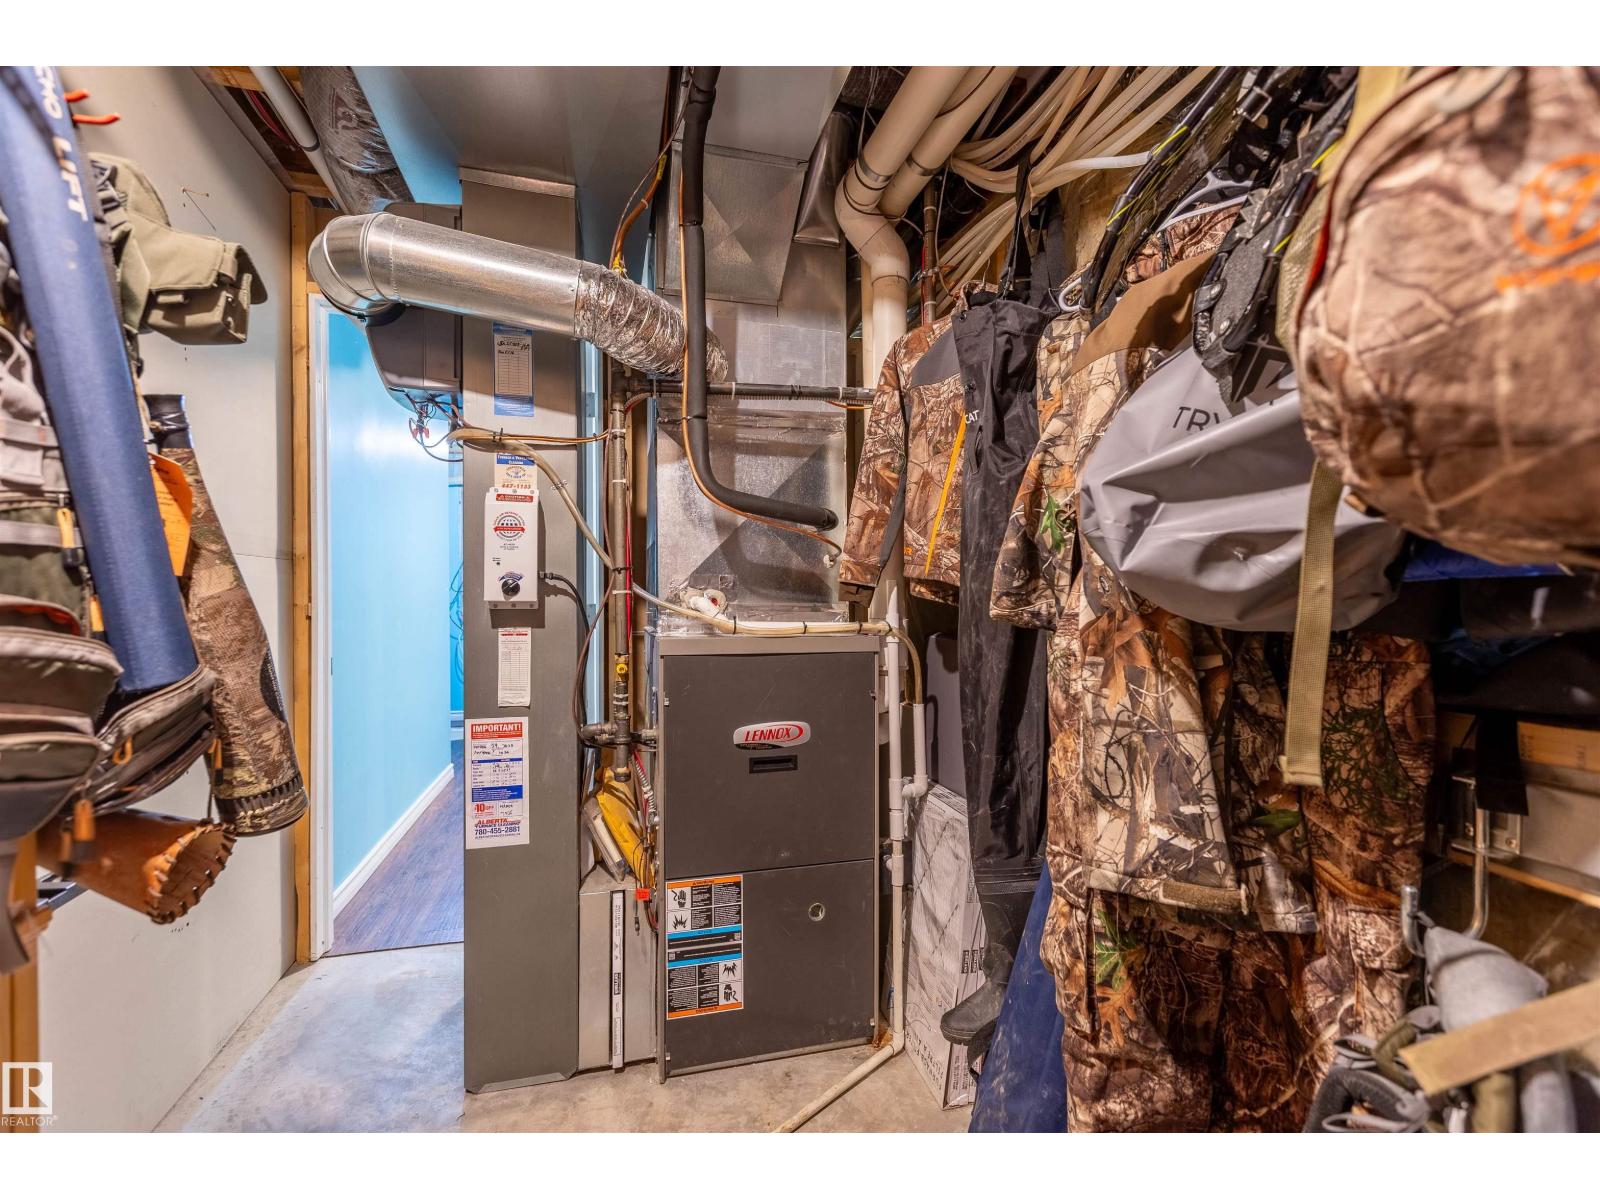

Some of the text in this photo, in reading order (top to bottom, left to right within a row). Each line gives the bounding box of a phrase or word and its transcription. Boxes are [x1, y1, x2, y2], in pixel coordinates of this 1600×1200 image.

[53, 137, 88, 221] LIFT
[473, 723, 521, 732] IMPORTANT!
[744, 727, 792, 742] LENNOX
